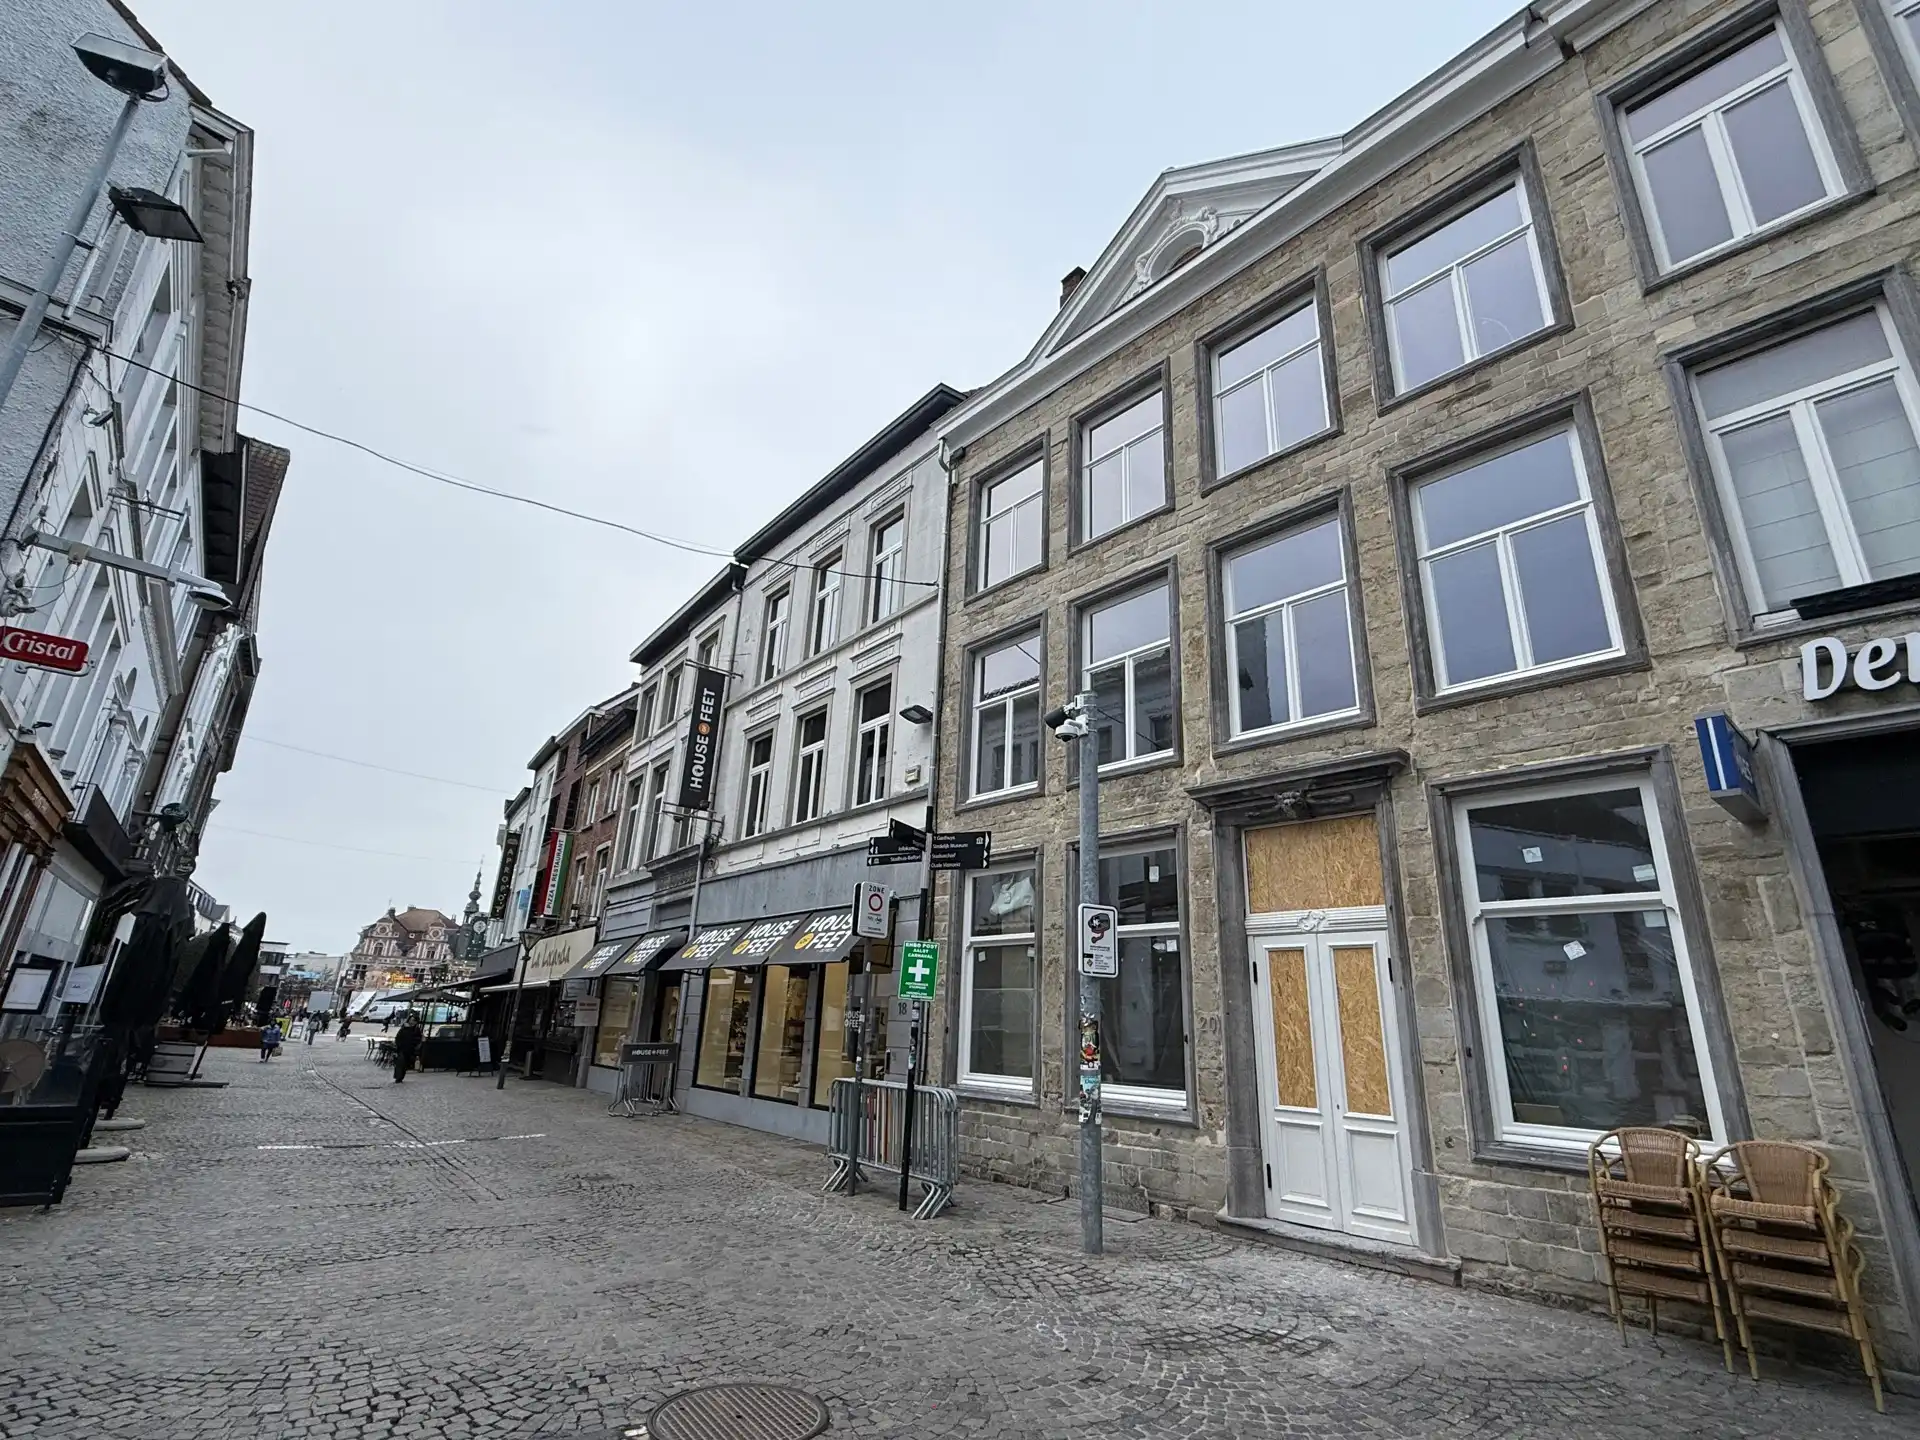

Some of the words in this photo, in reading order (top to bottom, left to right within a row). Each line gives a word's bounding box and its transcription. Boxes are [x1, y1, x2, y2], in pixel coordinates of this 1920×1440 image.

[3, 631, 77, 660] Cristal
[699, 687, 716, 722] FEET
[690, 735, 709, 789] HOUSE
[546, 889, 555, 909] PIZZA
[551, 839, 565, 882] RESTAURANT
[868, 884, 886, 895] ZONE
[743, 919, 801, 940] HOUSE
[804, 912, 853, 933] HOUS
[634, 935, 671, 950] HOUSE
[692, 926, 742, 945] HOUSE
[740, 935, 784, 955] FEET
[631, 948, 657, 963] FEET
[689, 942, 726, 959] FEET
[897, 1002, 908, 1015] 18
[631, 1048, 654, 1056] HOUSE
